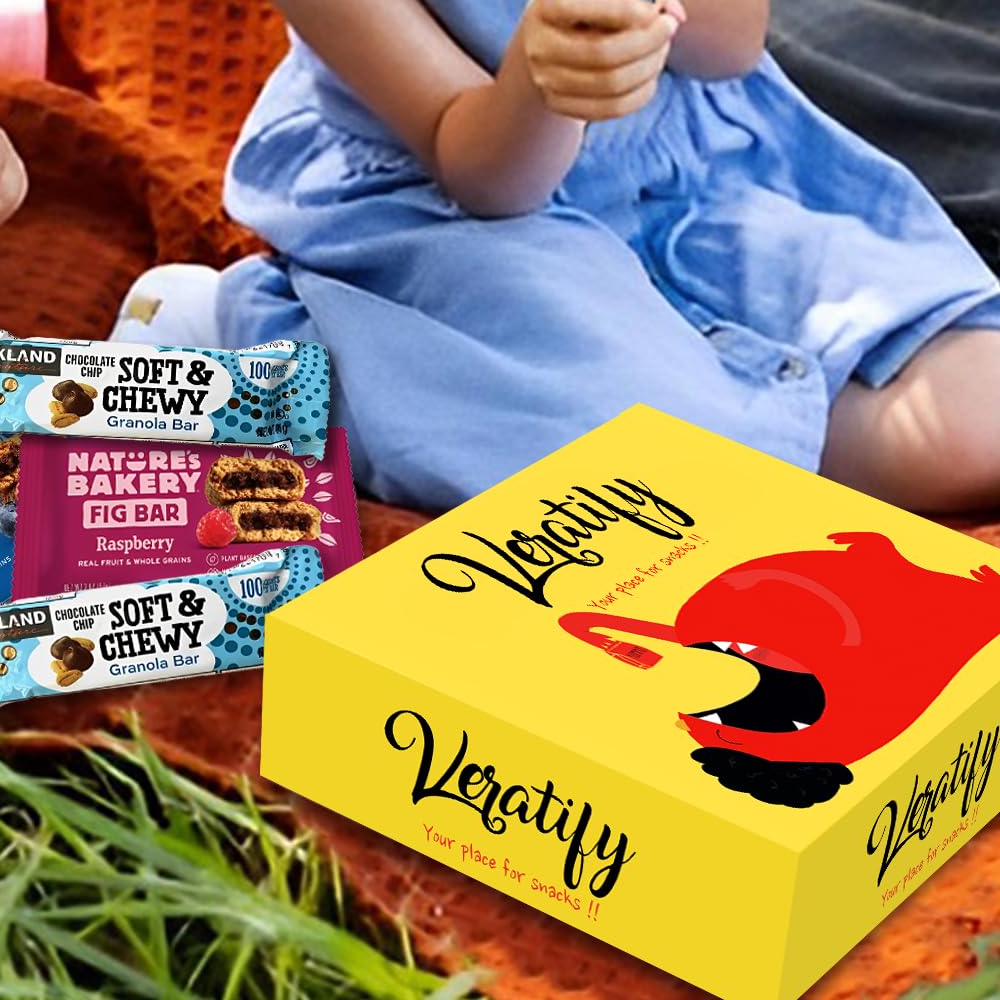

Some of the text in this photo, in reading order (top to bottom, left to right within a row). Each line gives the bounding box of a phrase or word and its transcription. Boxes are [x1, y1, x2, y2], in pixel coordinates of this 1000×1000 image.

[65, 354, 116, 368] CHOCOLATE
[80, 366, 103, 378] CHIP
[118, 357, 214, 386] SOFT &
[249, 360, 271, 380] 100
[102, 386, 209, 415] CHEWY
[107, 416, 199, 431] Granola Bar
[67, 472, 201, 496] BAKERY
[90, 503, 179, 523] FIG BAR
[96, 535, 174, 554] Raspberry
[421, 478, 695, 608] Veratify
[78, 559, 99, 567] REAL
[101, 558, 123, 566] FRUIT
[134, 557, 160, 565] WHOLE
[162, 556, 191, 565] GRAINS
[587, 592, 619, 610] Your
[615, 575, 645, 597] place
[636, 563, 663, 577] for
[659, 542, 697, 566] snacks
[240, 577, 263, 599] 100
[55, 603, 106, 621] CHOCOLATE
[109, 589, 206, 630] SOFT &
[73, 619, 95, 631] CHIP
[100, 620, 204, 661] CHEWY
[109, 653, 200, 676] Granola Bar
[384, 709, 637, 898] Veratify
[423, 823, 456, 850] Your
[461, 843, 497, 869] place
[503, 859, 526, 884] for
[531, 878, 581, 910] snacks
[881, 881, 901, 908] Your
[902, 859, 925, 889] place
[926, 844, 941, 863] for
[941, 817, 970, 851] snacks
